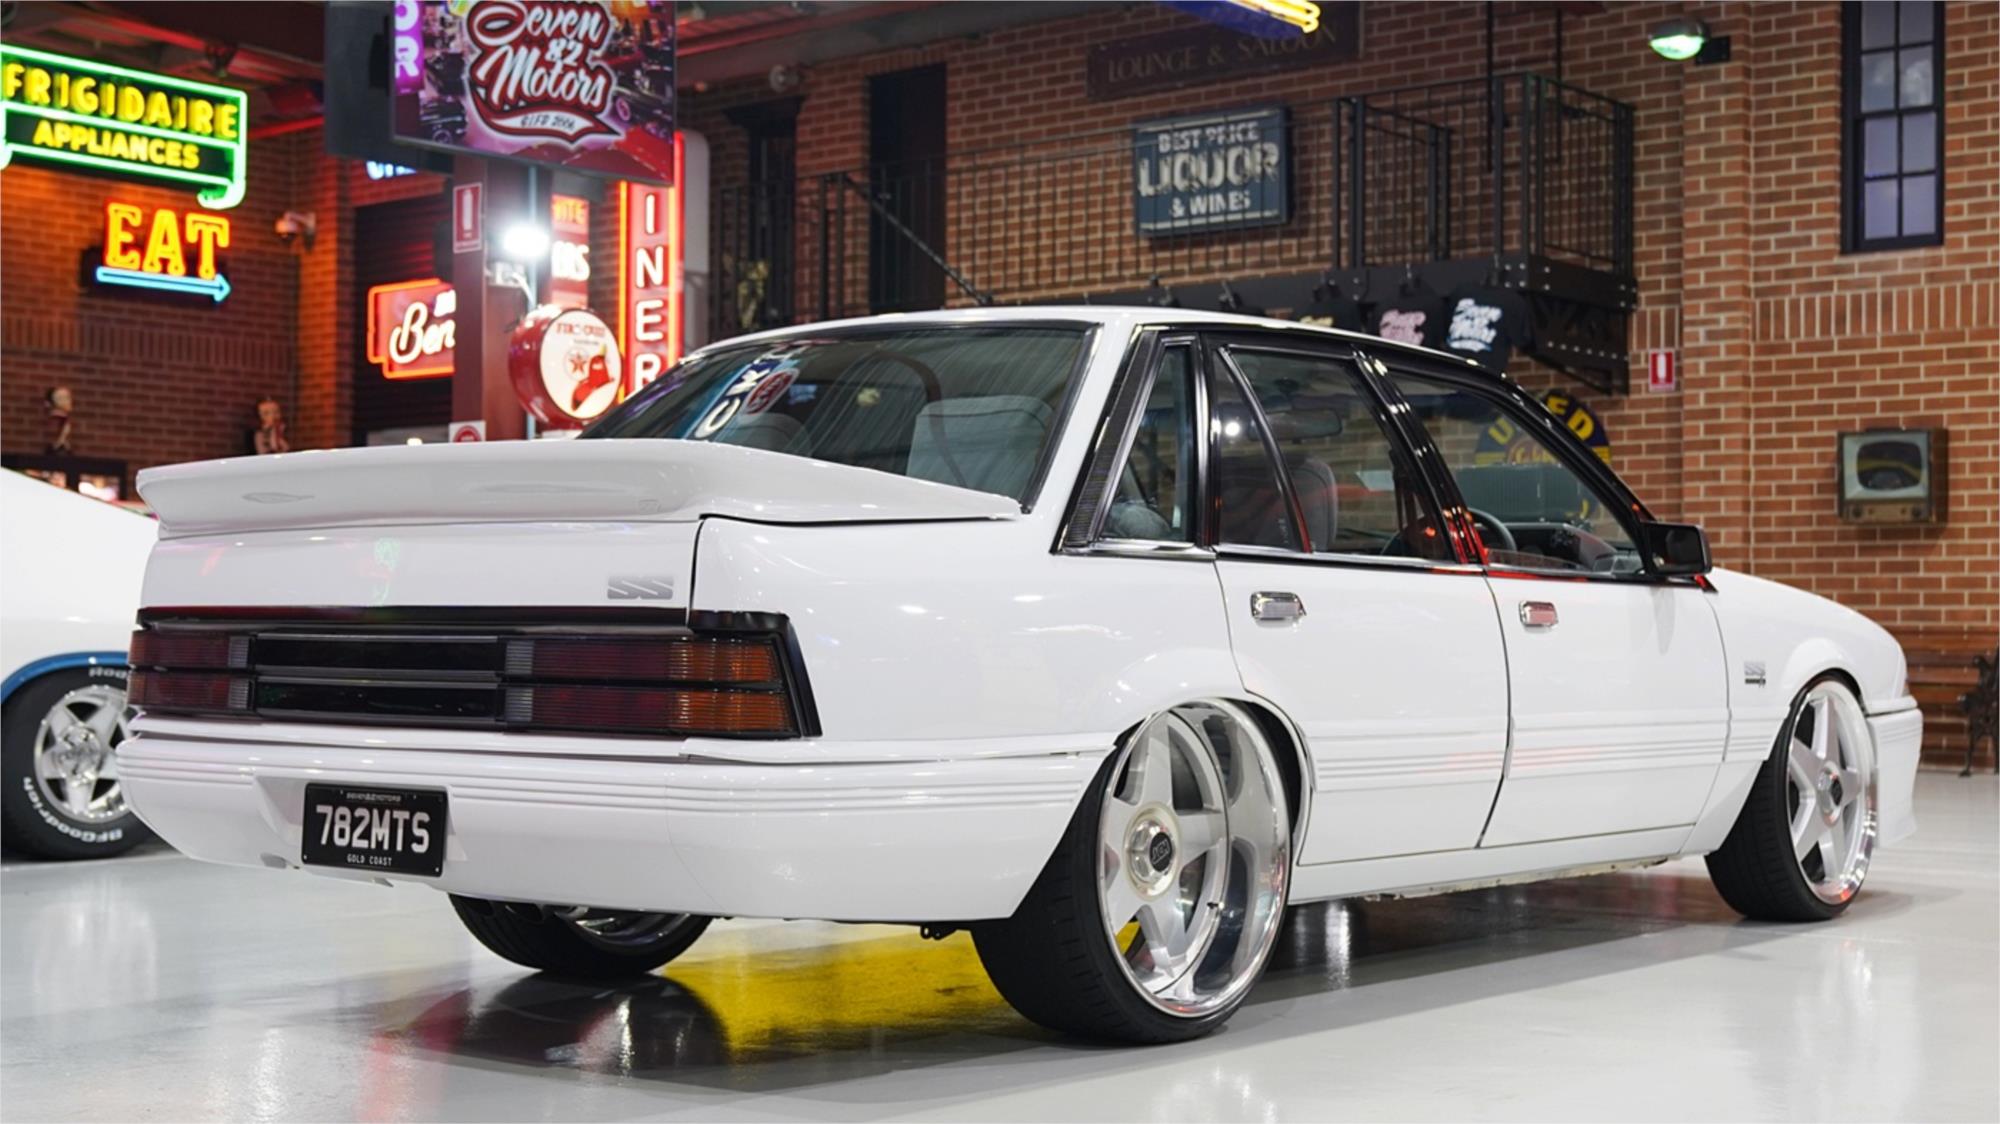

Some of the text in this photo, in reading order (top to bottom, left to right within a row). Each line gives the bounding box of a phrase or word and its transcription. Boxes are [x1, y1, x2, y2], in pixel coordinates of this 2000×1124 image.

[473, 0, 605, 47] Seven
[476, 44, 607, 108] Motors
[545, 38, 583, 67] 82
[1108, 44, 1199, 83] LOUNGE
[1206, 44, 1226, 66] &
[4, 62, 238, 138] FRIGIDAIRE
[33, 119, 200, 169] APPLIANCES
[1158, 120, 1259, 153] BEST PRICE
[1137, 141, 1281, 197] LIQUOR
[1170, 190, 1251, 218] & WINES
[105, 202, 230, 281] EAT
[607, 576, 674, 600] SS
[316, 804, 431, 854] 782MTS
[347, 853, 393, 867] GOLD COAST
